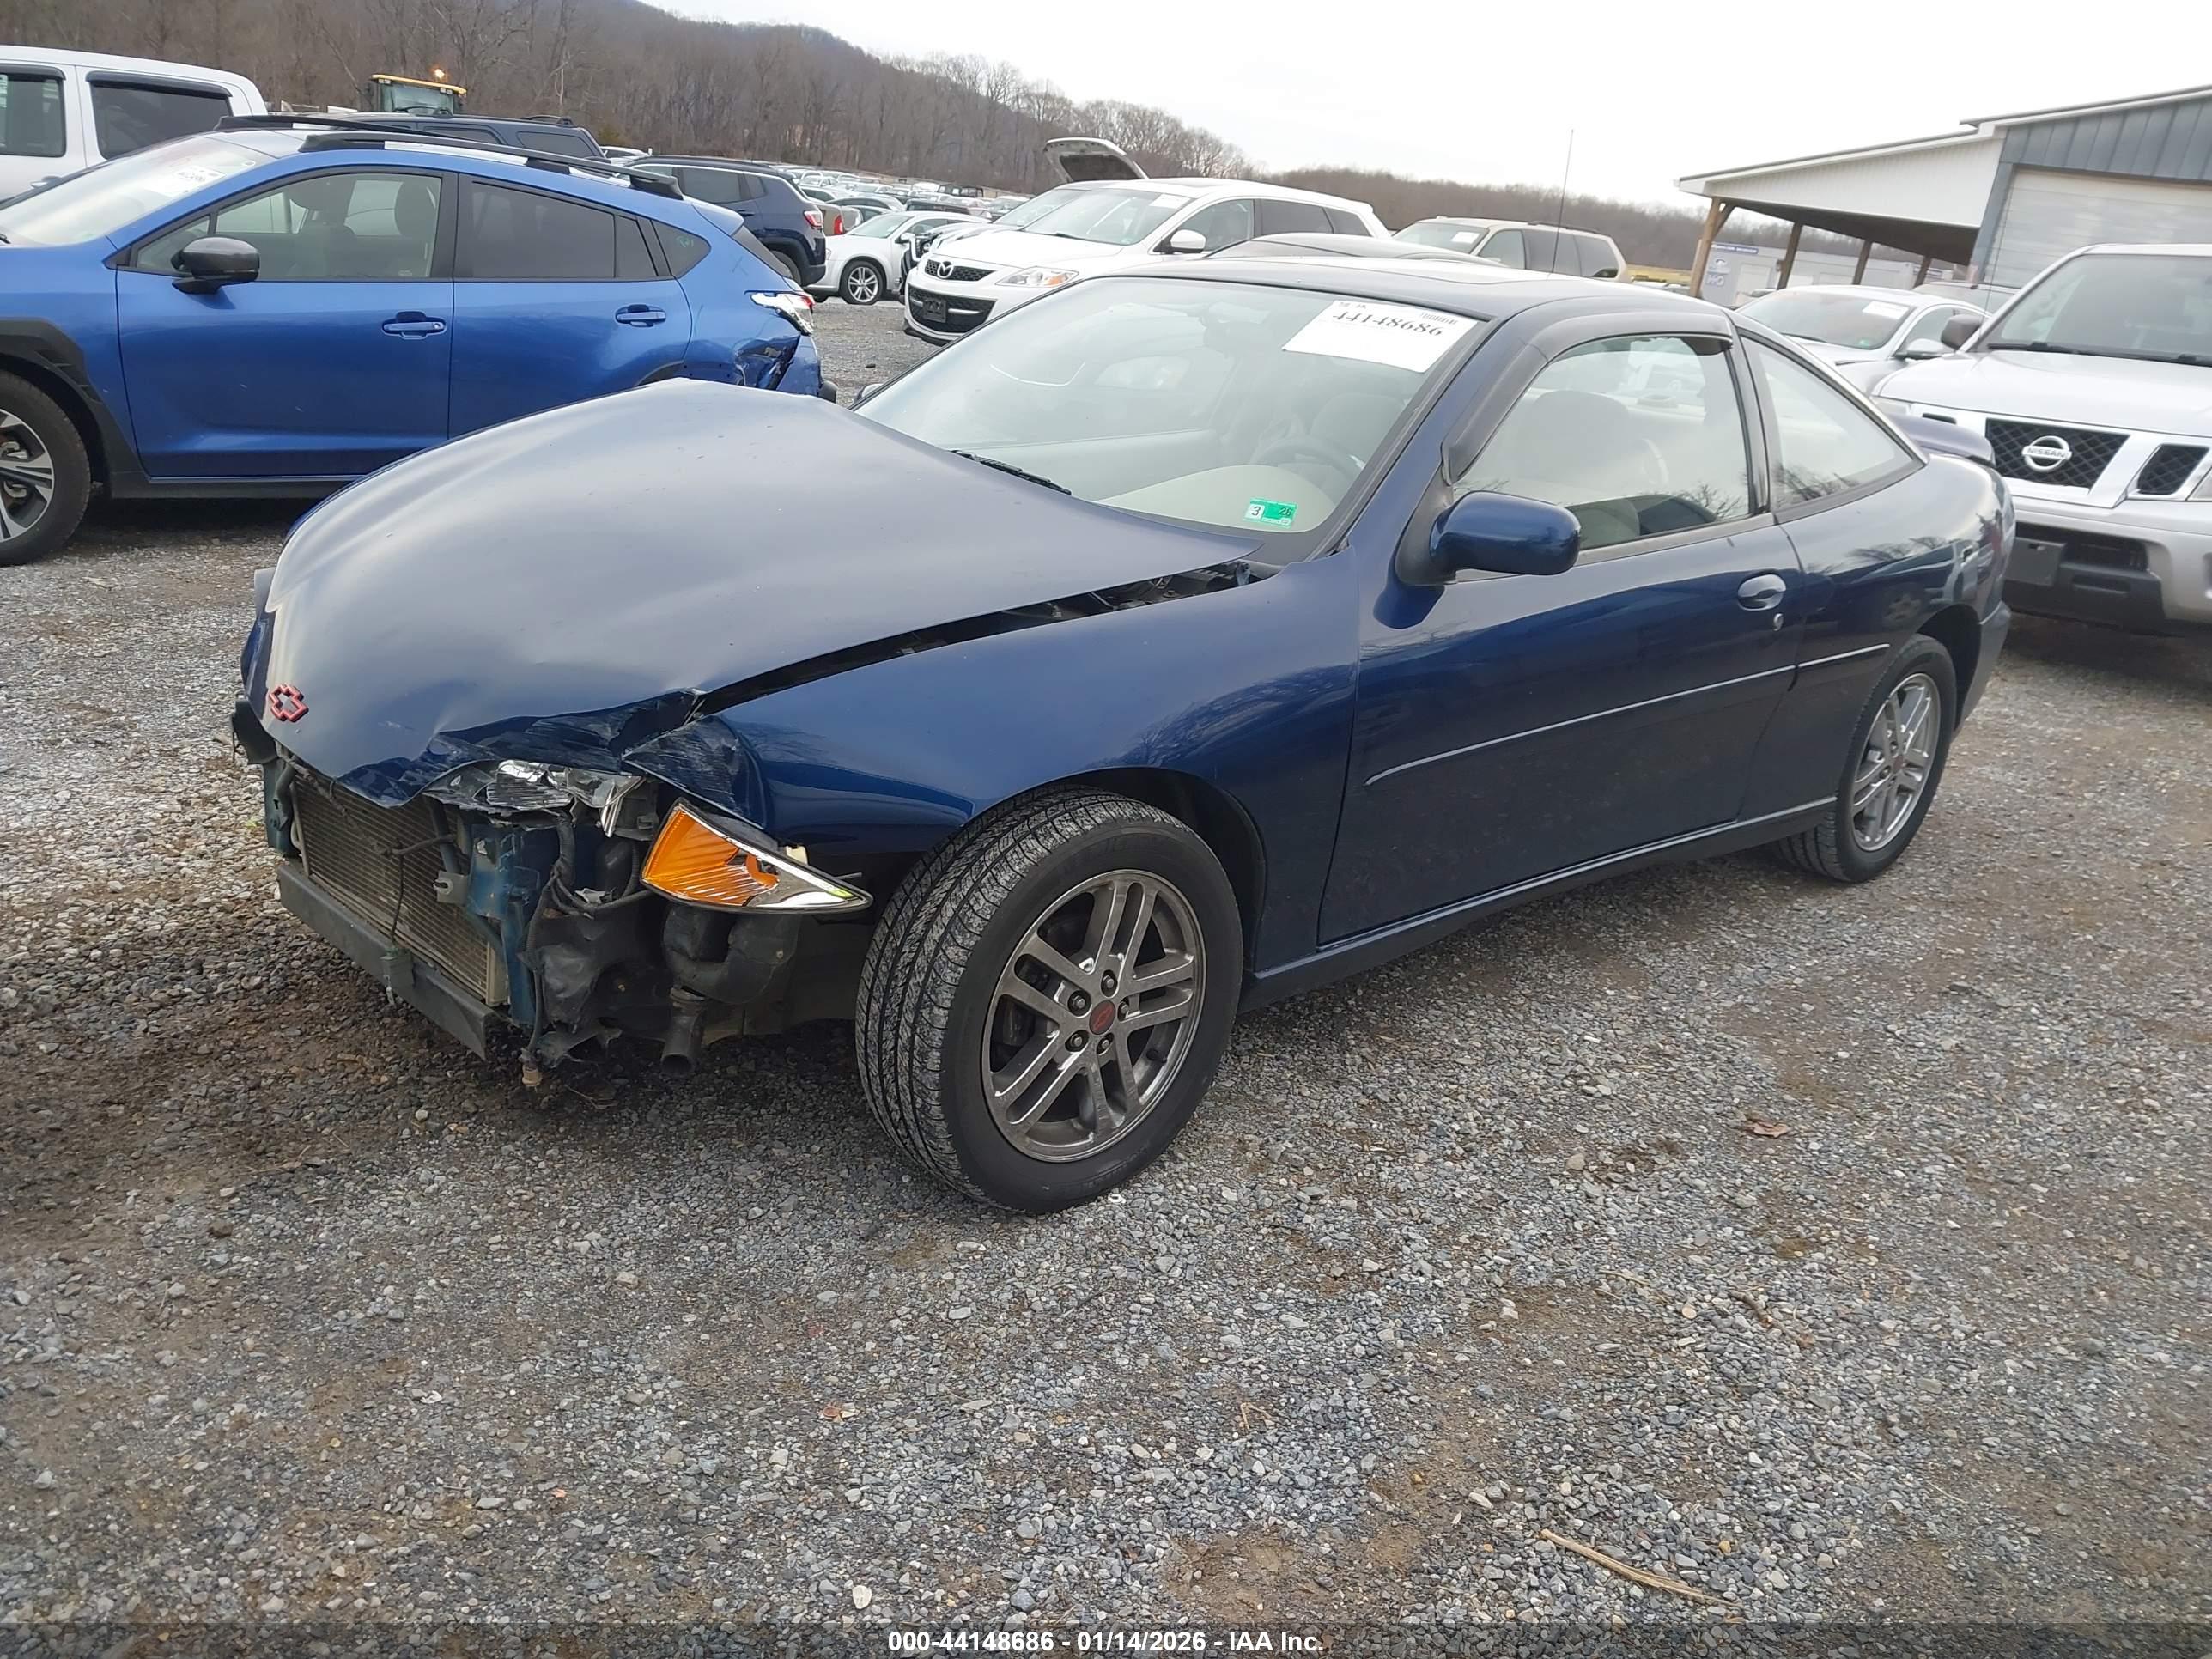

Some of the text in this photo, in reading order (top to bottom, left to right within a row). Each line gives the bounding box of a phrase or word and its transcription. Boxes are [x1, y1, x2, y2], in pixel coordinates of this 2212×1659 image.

[1332, 311, 1443, 337] 44148686
[2027, 447, 2065, 458] NISSAN
[1251, 506, 1293, 517] 3 26
